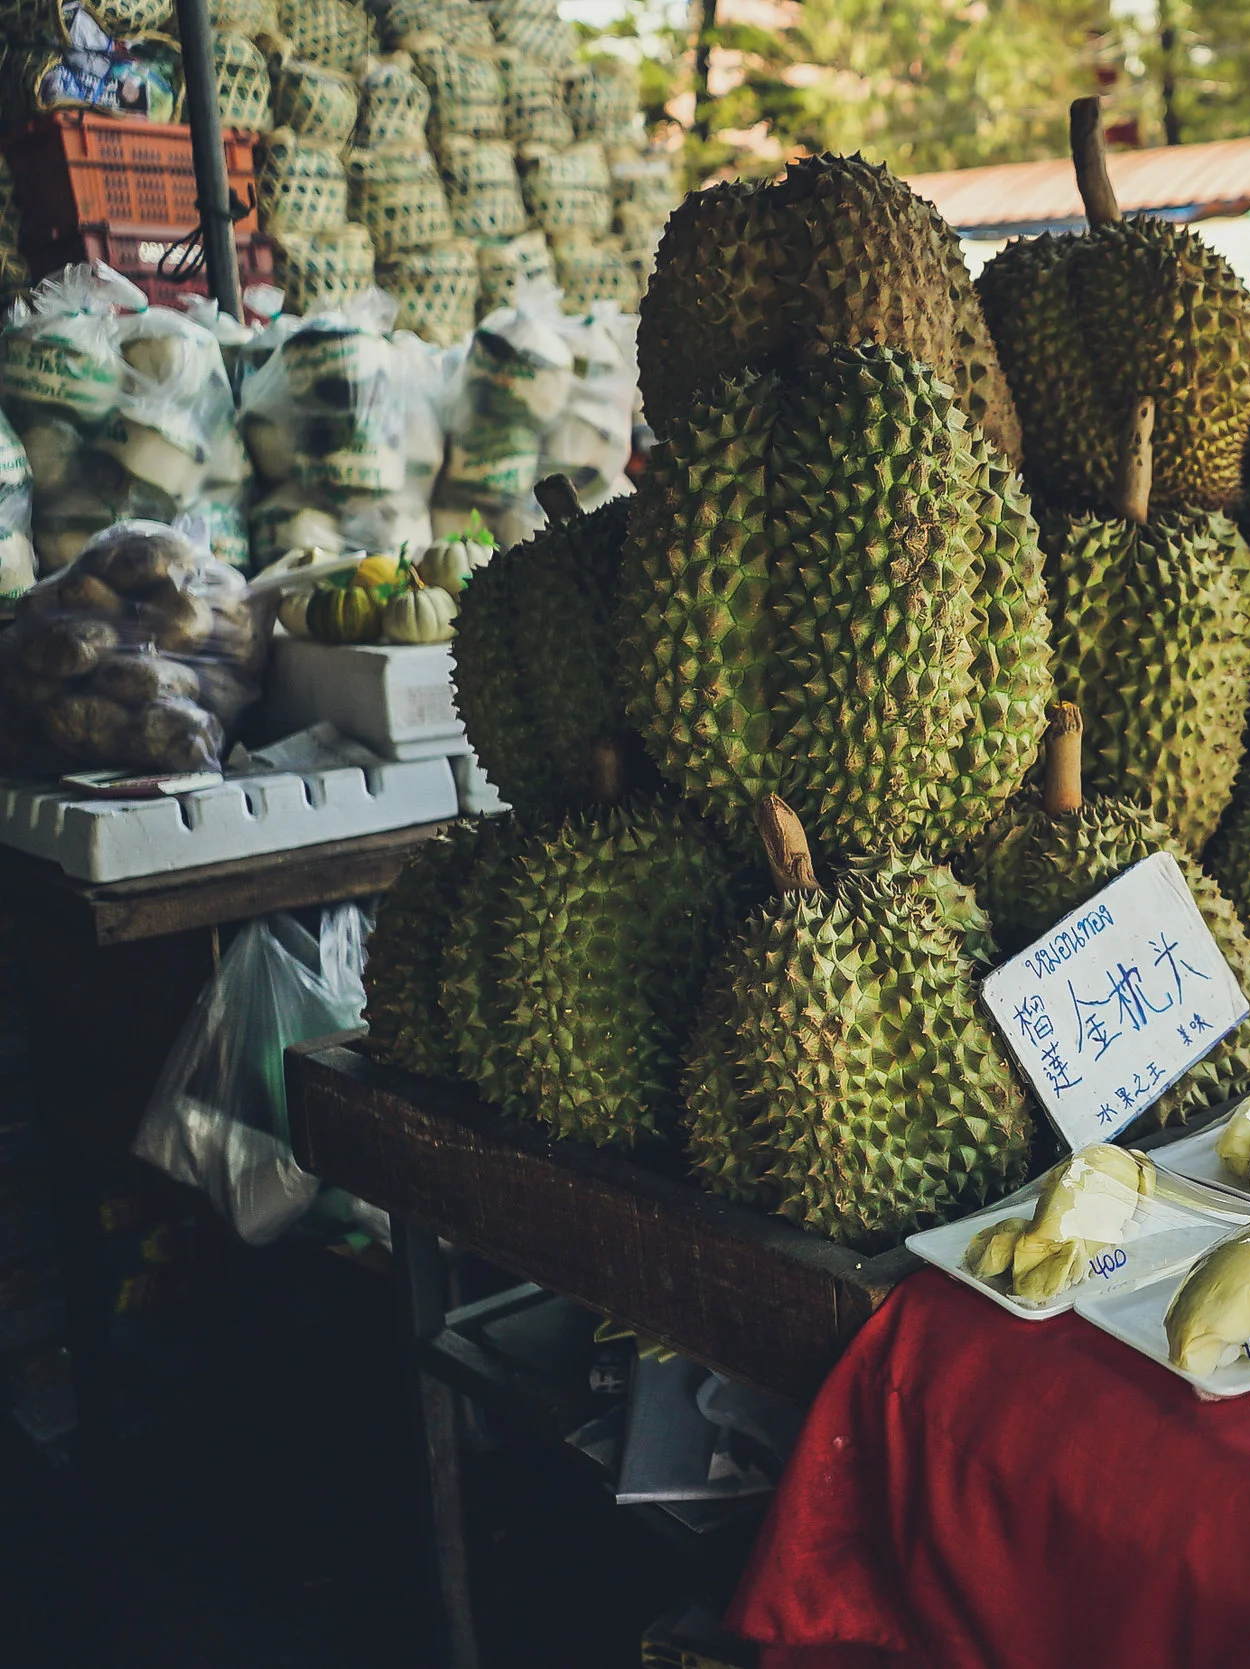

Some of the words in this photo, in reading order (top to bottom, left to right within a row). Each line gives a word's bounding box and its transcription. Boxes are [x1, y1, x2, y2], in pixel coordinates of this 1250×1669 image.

[1025, 904, 1114, 979] หมอนทอง
[1067, 931, 1212, 1062] 金枕头
[1095, 1061, 1166, 1126] 水果之王
[1089, 1248, 1127, 1280] 400
